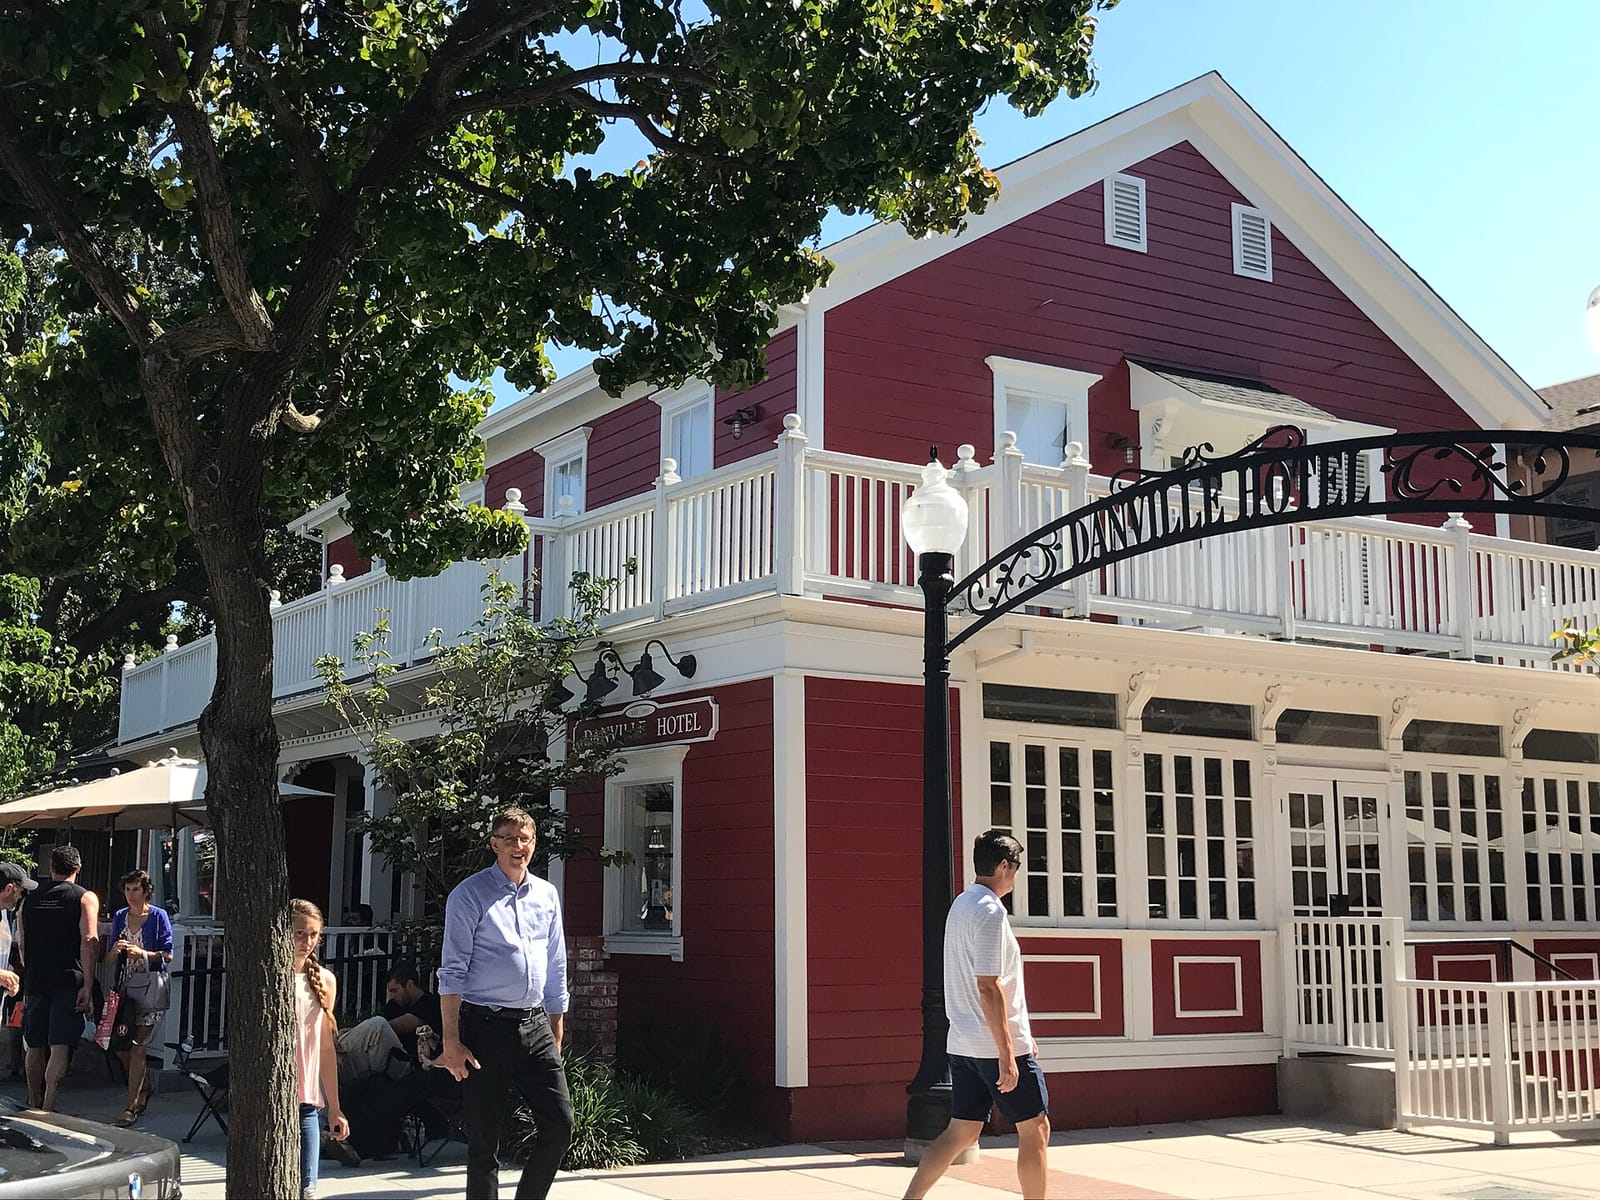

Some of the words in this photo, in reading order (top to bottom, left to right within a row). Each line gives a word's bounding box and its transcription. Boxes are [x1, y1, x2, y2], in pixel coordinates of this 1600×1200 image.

[1069, 471, 1225, 565] DANVILLE
[1238, 450, 1371, 519] HOTEL
[656, 711, 702, 737] HOTEL
